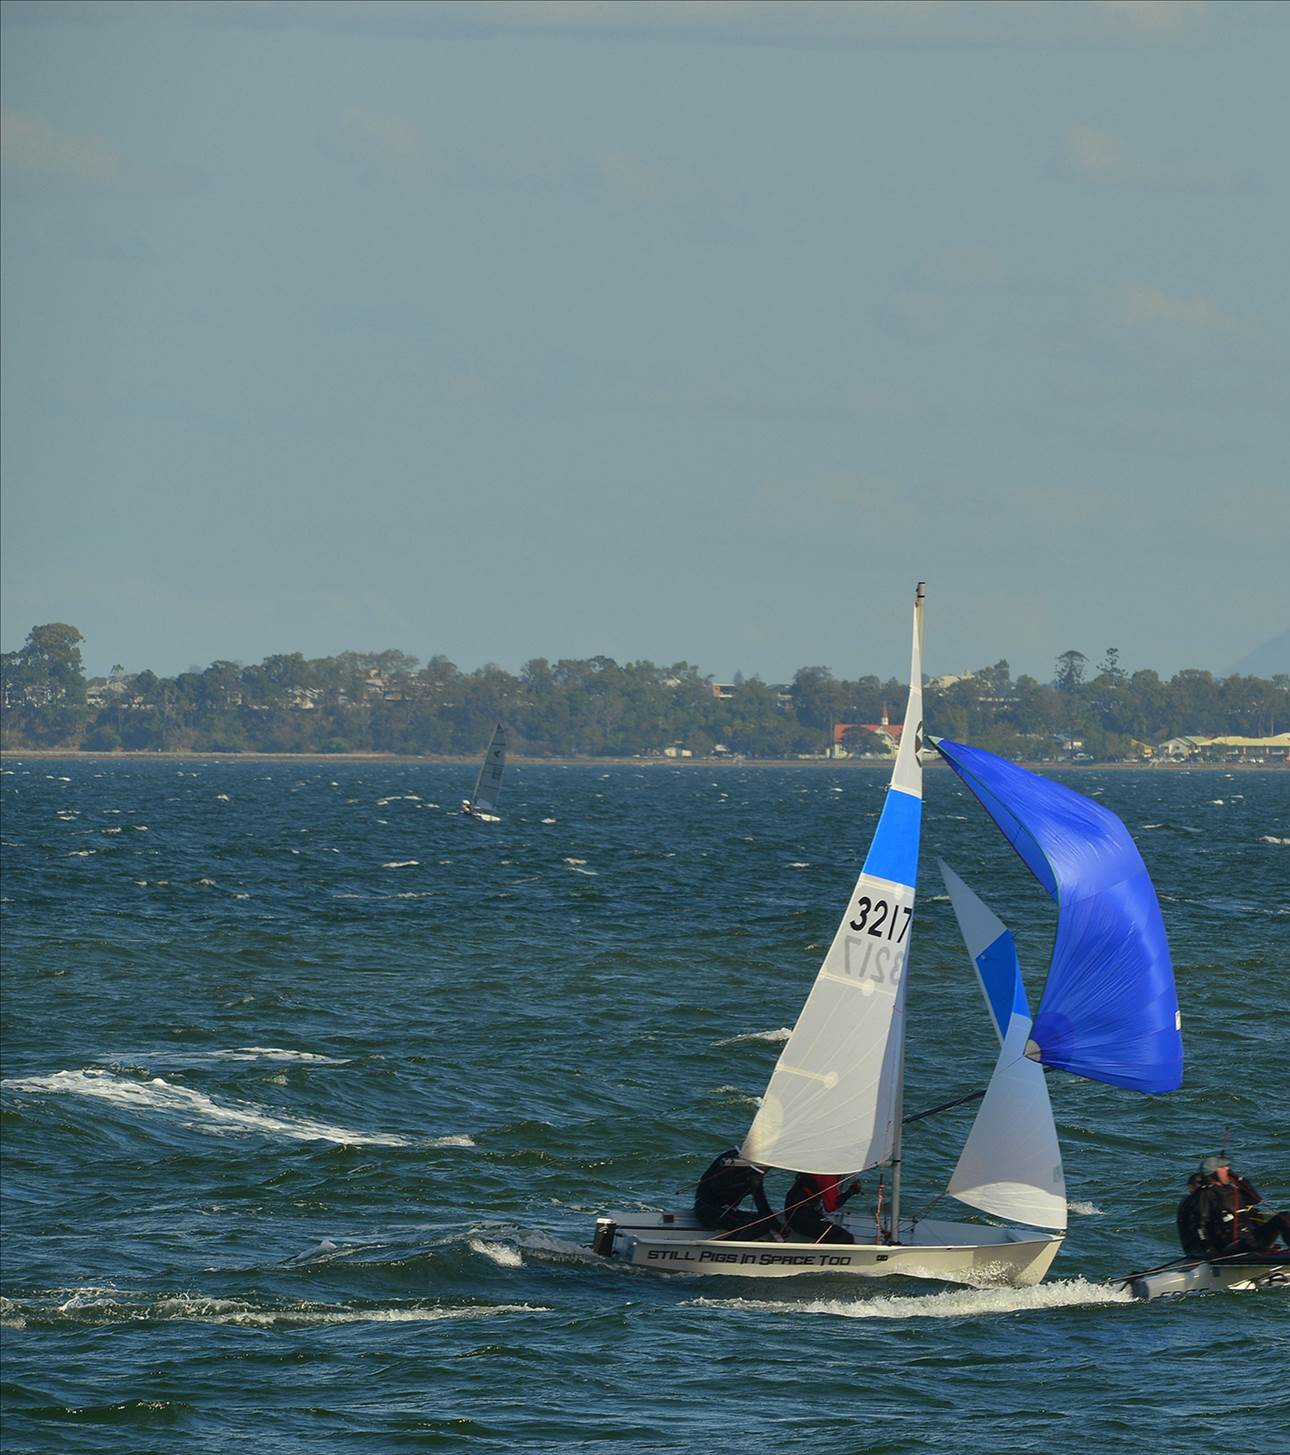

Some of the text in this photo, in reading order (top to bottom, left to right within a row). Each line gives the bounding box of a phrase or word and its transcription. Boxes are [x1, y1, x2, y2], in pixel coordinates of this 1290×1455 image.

[849, 896, 912, 943] 3217
[647, 1250, 695, 1260] STILL
[699, 1250, 738, 1264] PIGS
[759, 1253, 817, 1266] SPACE
[819, 1255, 852, 1266] TOO
